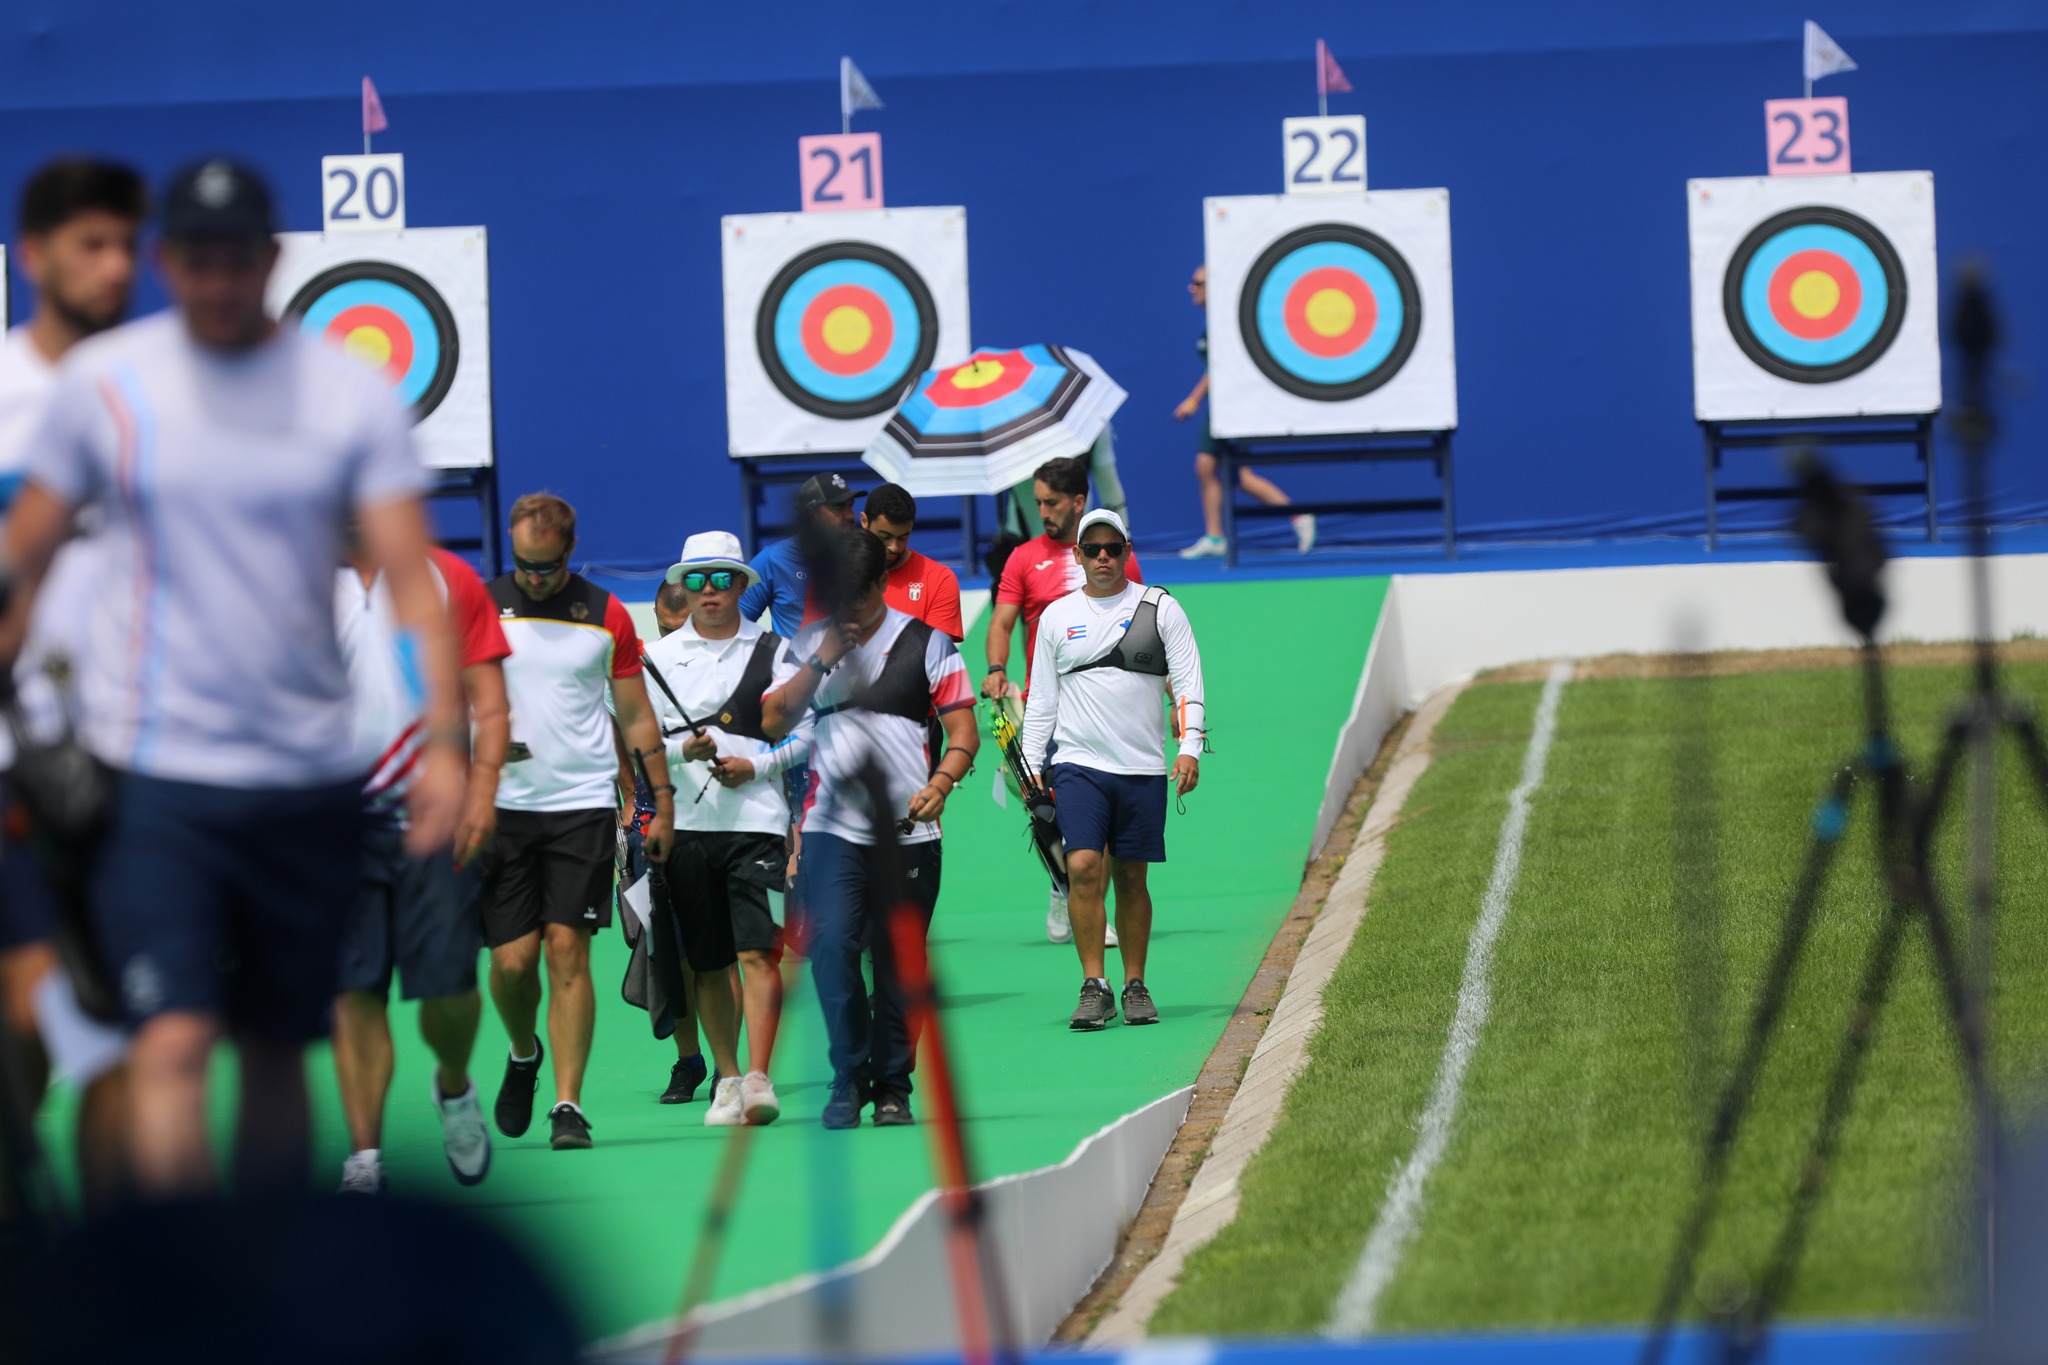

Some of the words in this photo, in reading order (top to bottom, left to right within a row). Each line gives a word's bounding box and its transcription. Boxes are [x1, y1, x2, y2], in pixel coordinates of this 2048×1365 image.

[1291, 128, 1361, 182] 22
[1774, 110, 1844, 164] 23
[328, 166, 399, 220] 20
[811, 146, 873, 203] 21
